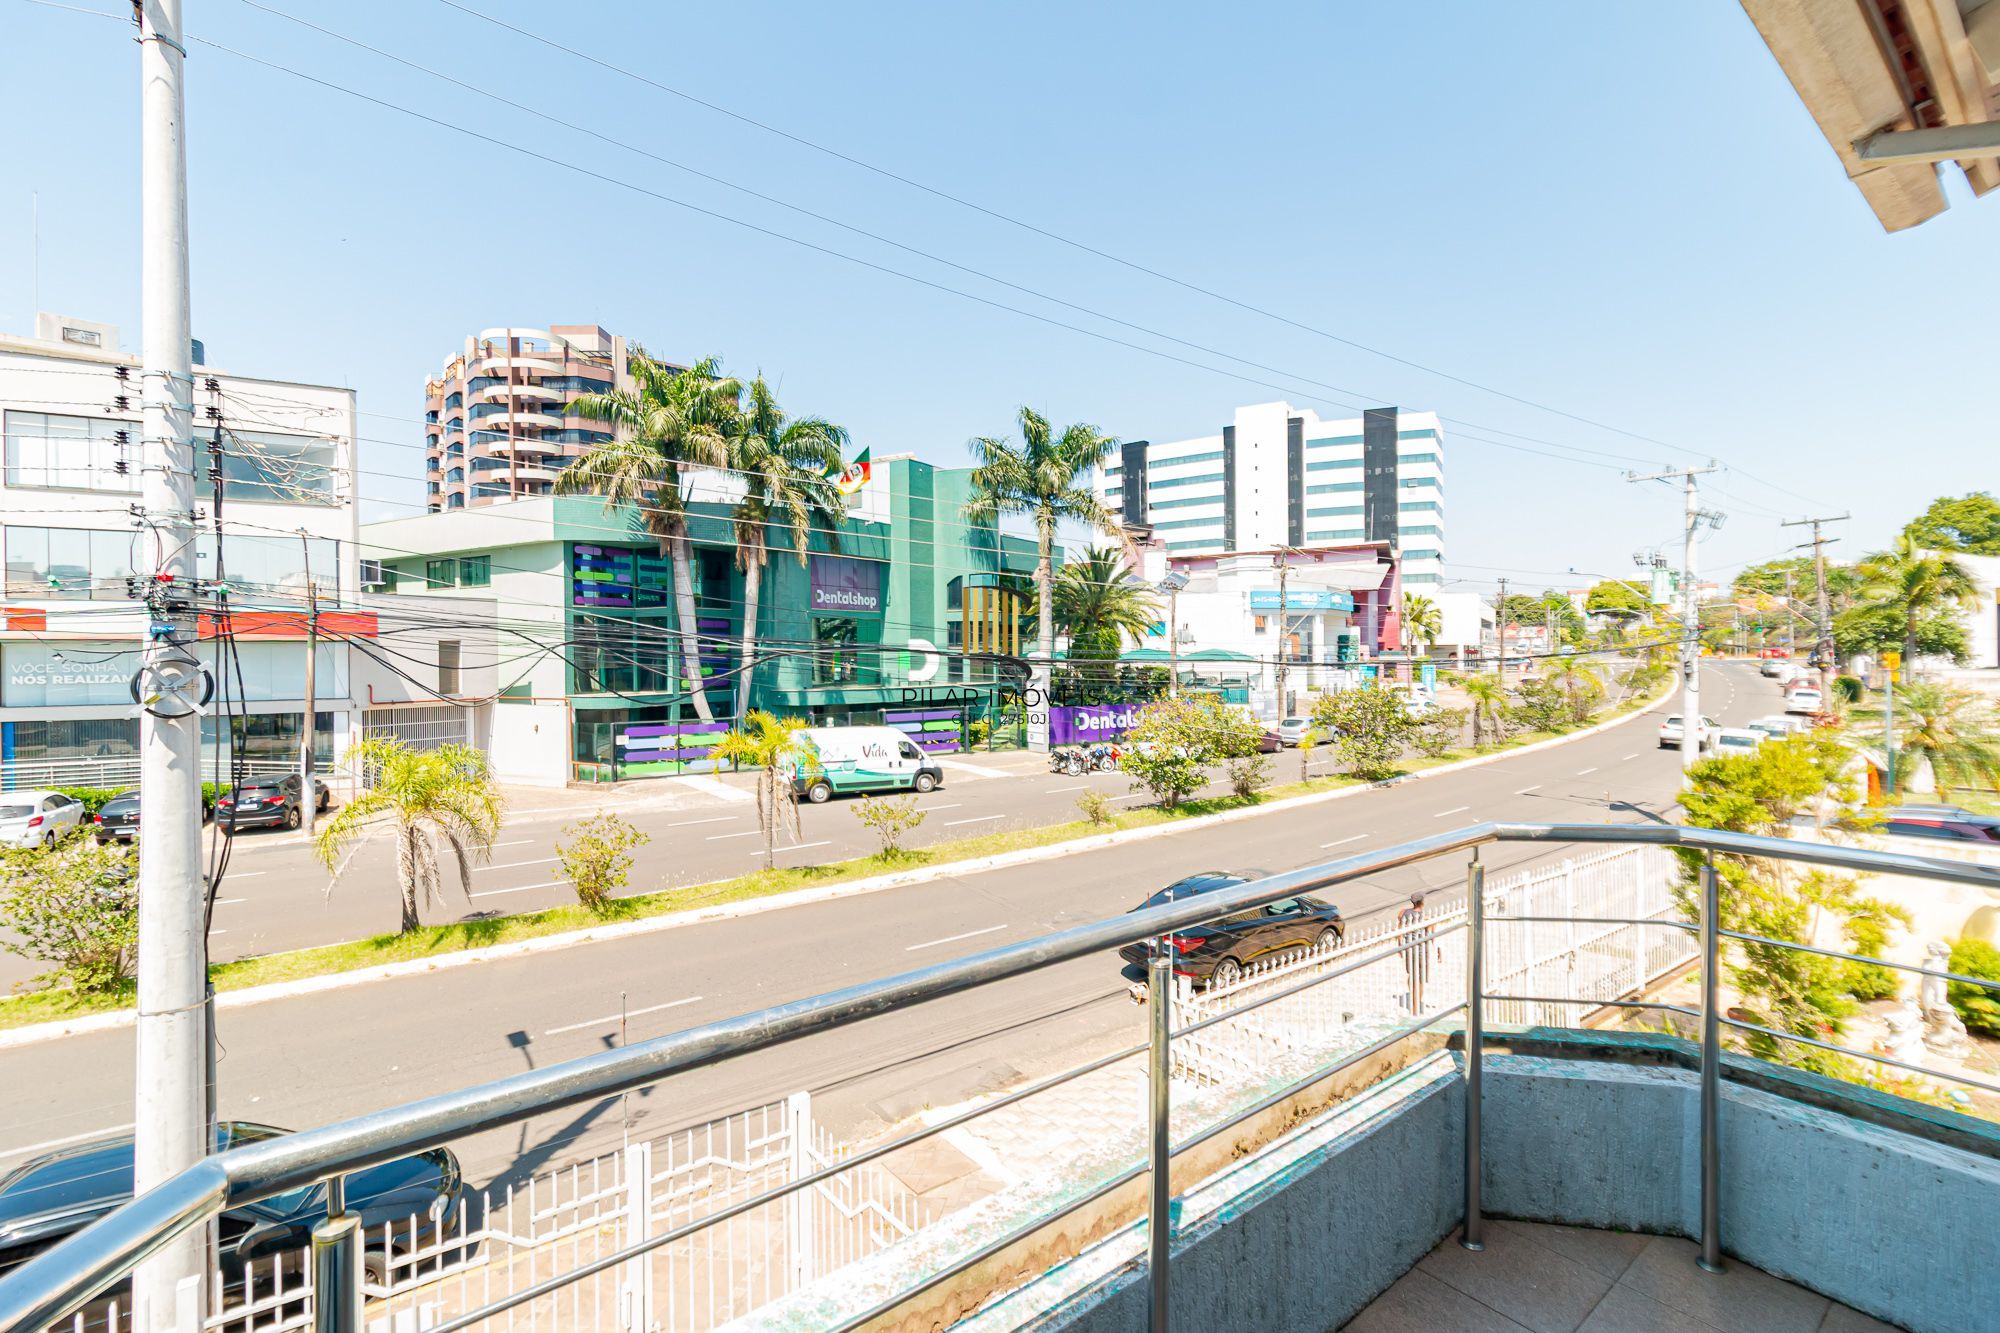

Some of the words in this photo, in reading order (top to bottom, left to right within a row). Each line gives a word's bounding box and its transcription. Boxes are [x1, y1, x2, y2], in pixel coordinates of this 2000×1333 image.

[815, 589, 877, 609] Dentalshop
[11, 674, 47, 685] NÓS
[862, 743, 888, 758] Vida
